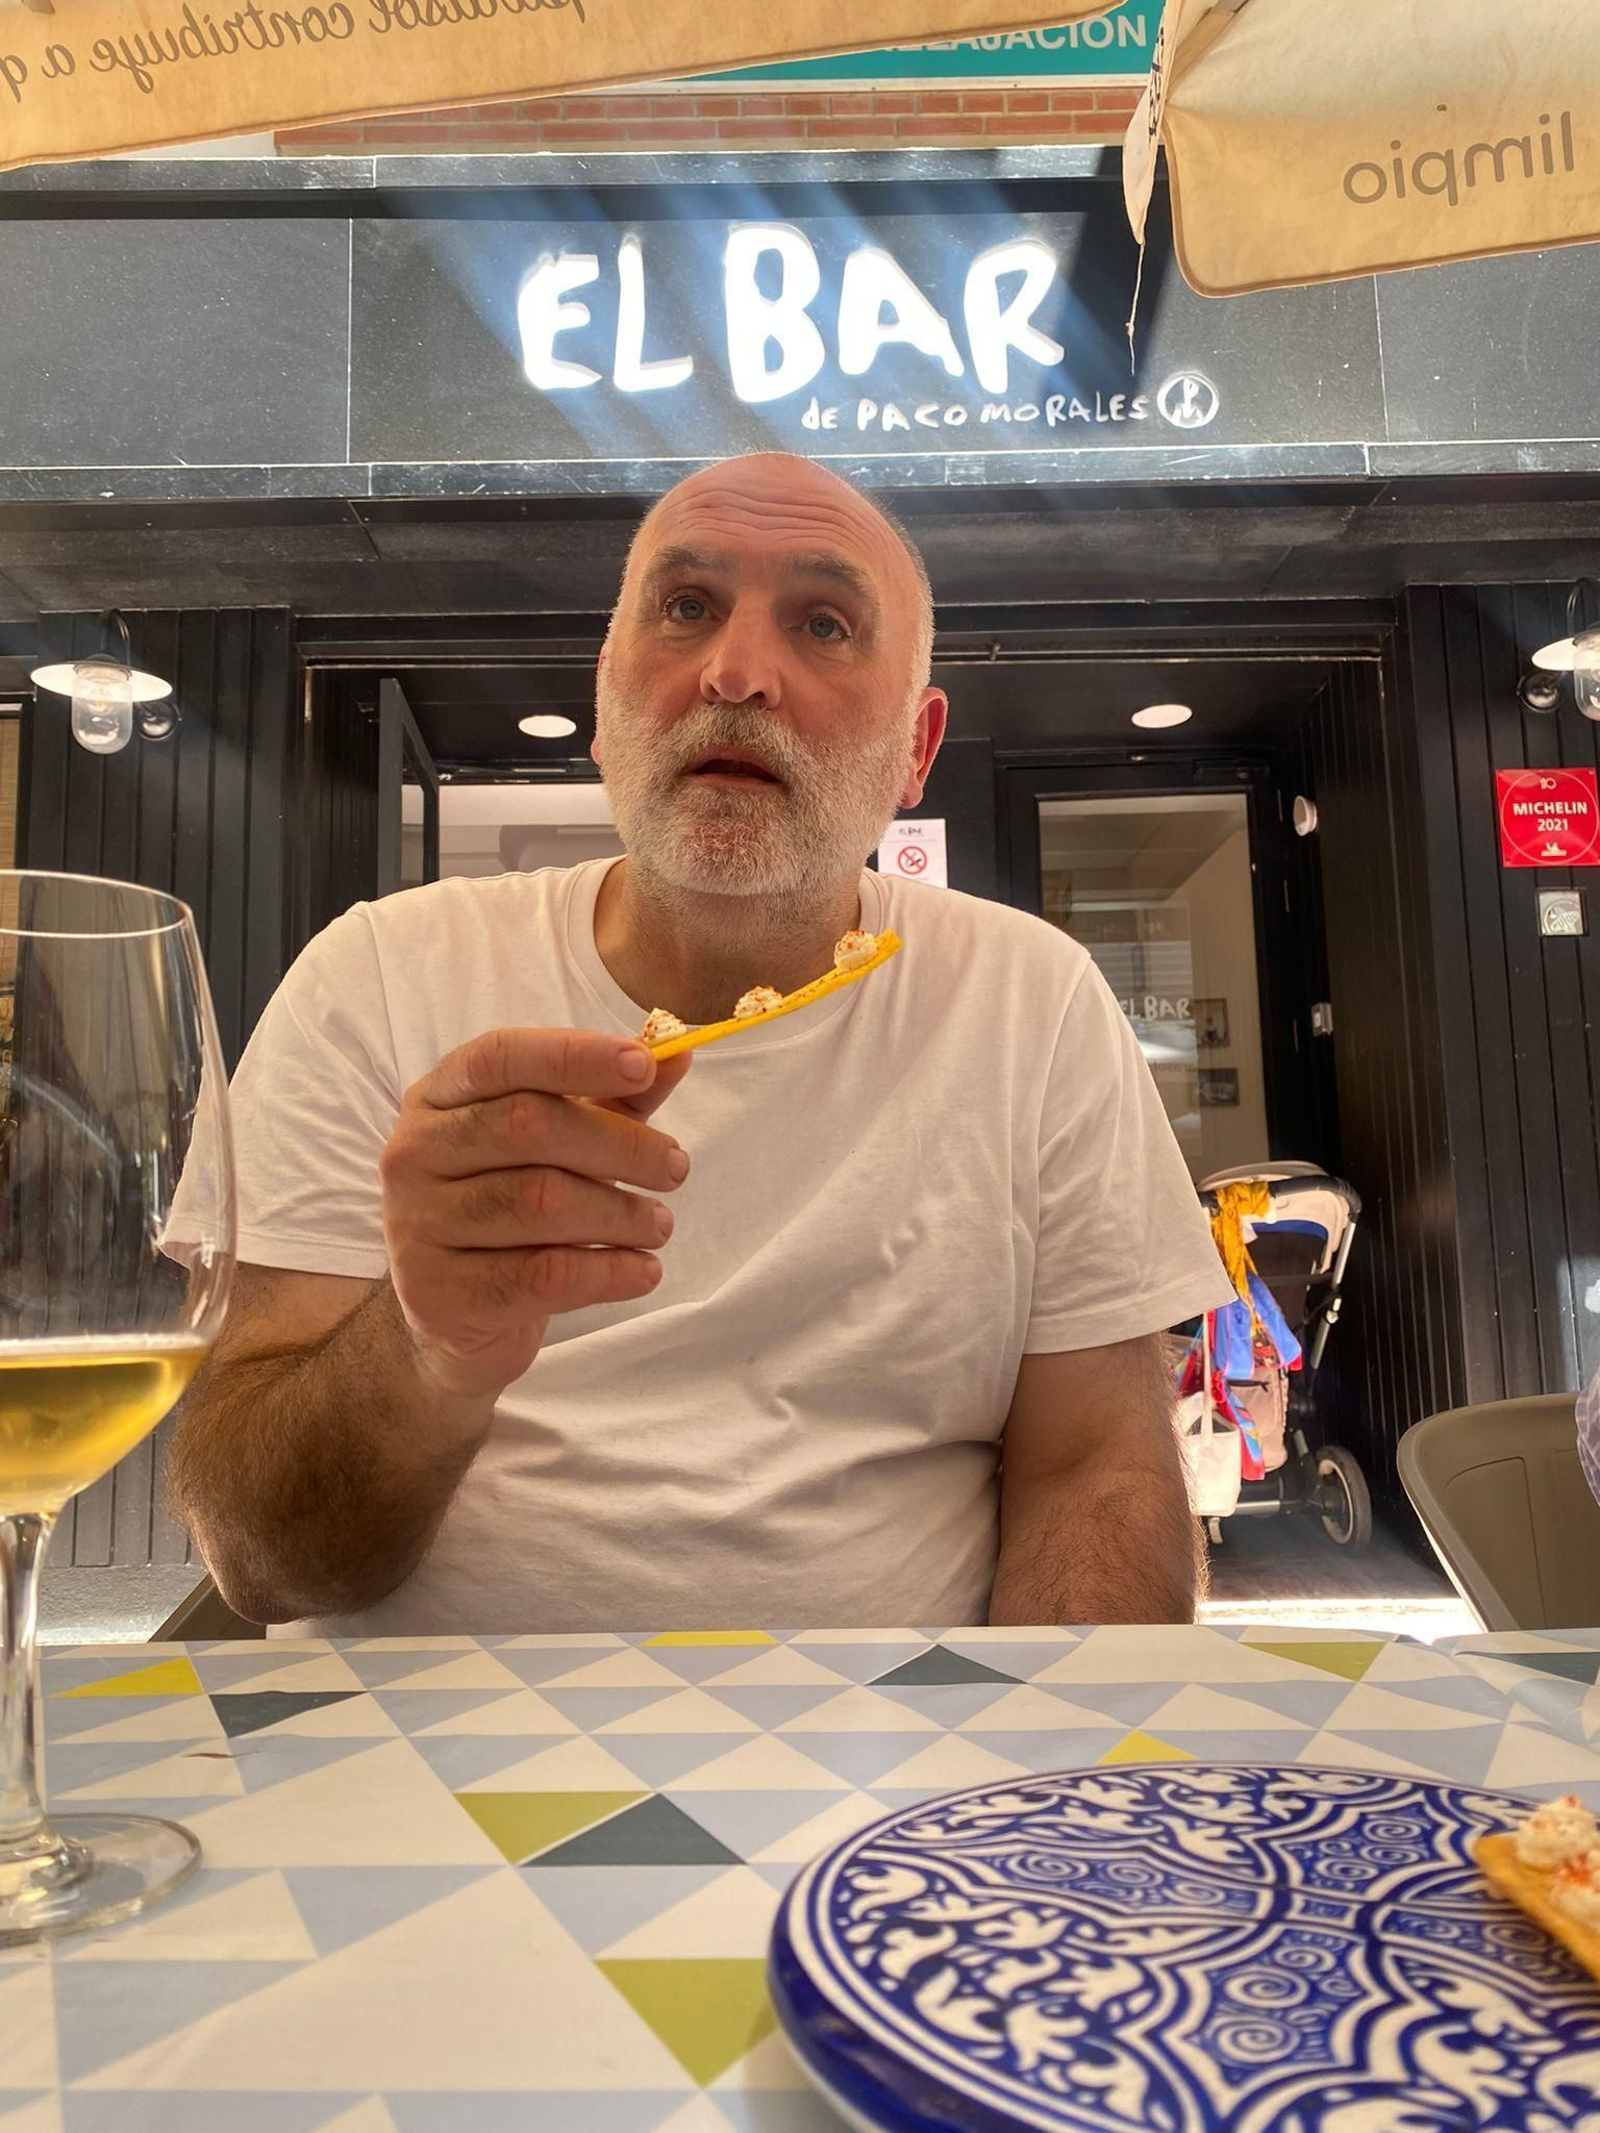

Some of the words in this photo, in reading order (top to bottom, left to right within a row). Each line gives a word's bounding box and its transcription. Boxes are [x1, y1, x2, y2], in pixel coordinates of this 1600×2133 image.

[517, 235, 694, 393] EL
[725, 222, 1065, 402] BAR
[801, 398, 838, 431] de
[857, 402, 967, 431] PACO
[980, 393, 1149, 427] MORALES
[1513, 801, 1588, 815] MICHELIN
[1537, 818, 1568, 832] 2021
[1144, 995, 1191, 1022] BAR
